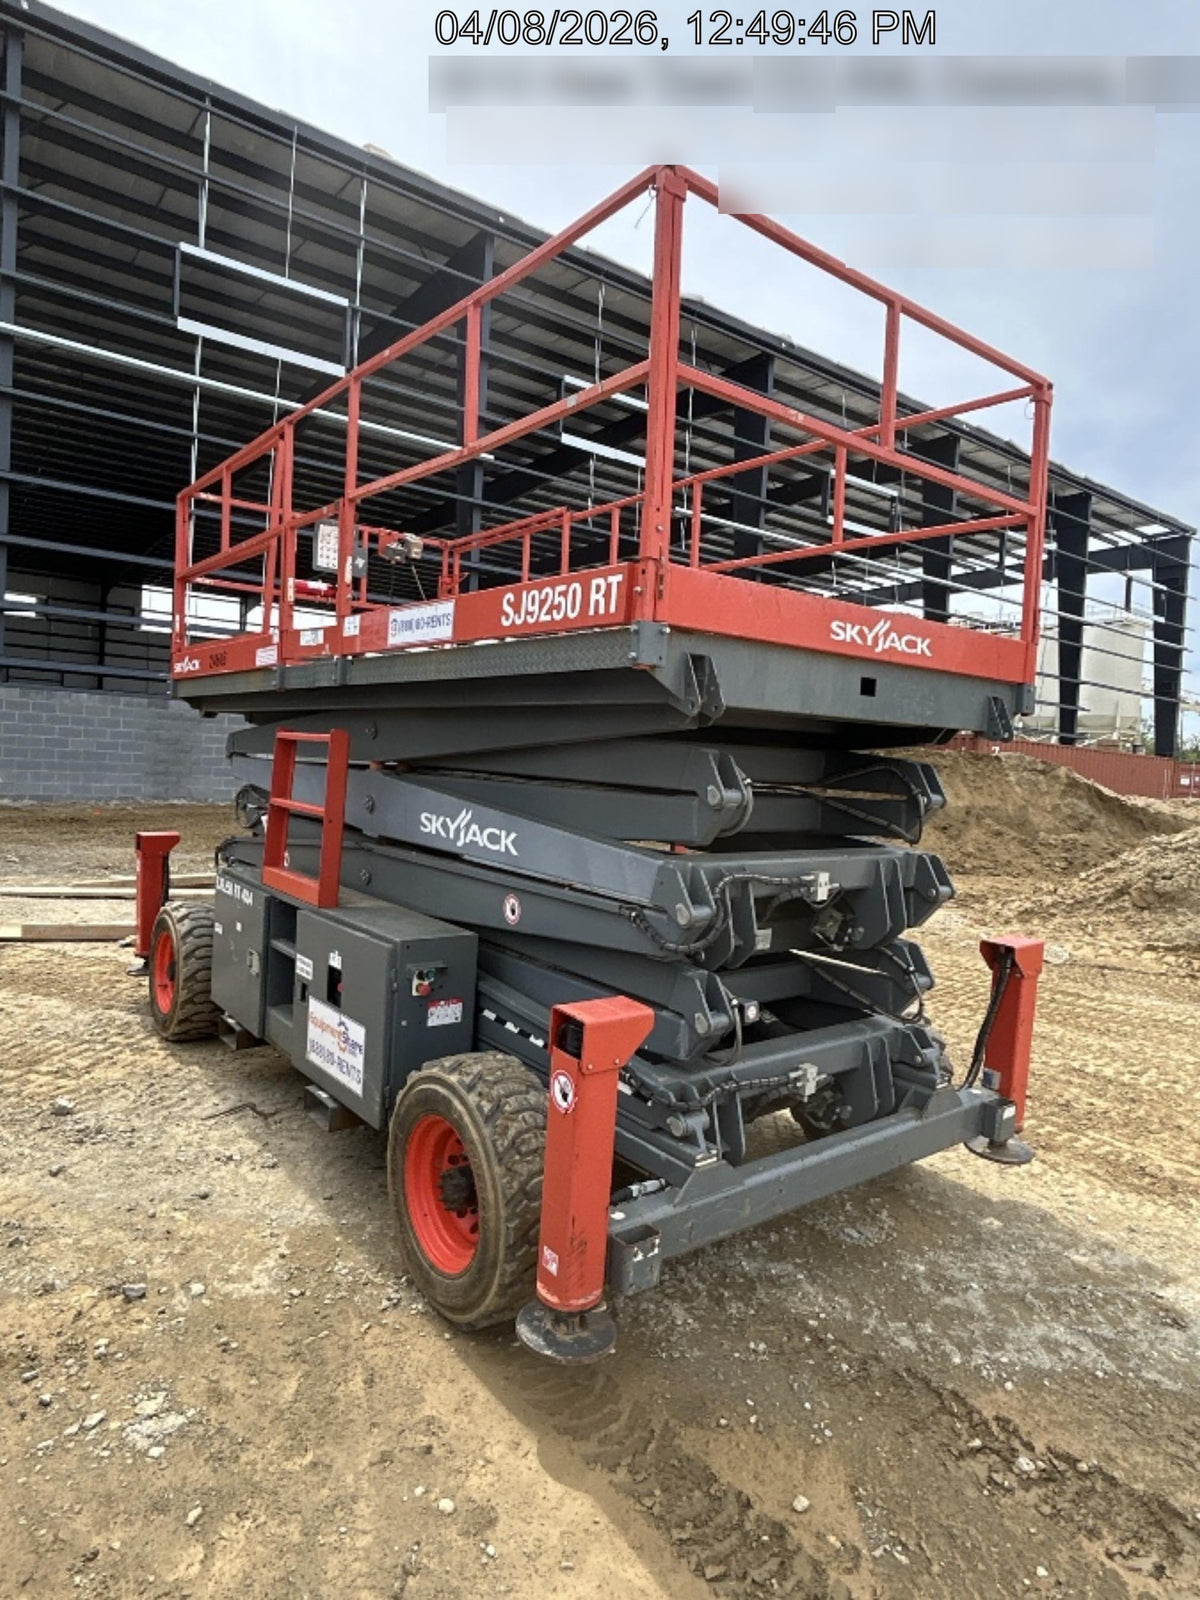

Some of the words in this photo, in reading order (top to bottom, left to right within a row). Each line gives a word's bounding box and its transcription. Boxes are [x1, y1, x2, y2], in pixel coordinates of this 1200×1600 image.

[501, 582, 582, 627] SJ9250
[588, 574, 623, 616] RT
[829, 618, 933, 657] SKYJACK
[419, 808, 519, 856] SKYJACK
